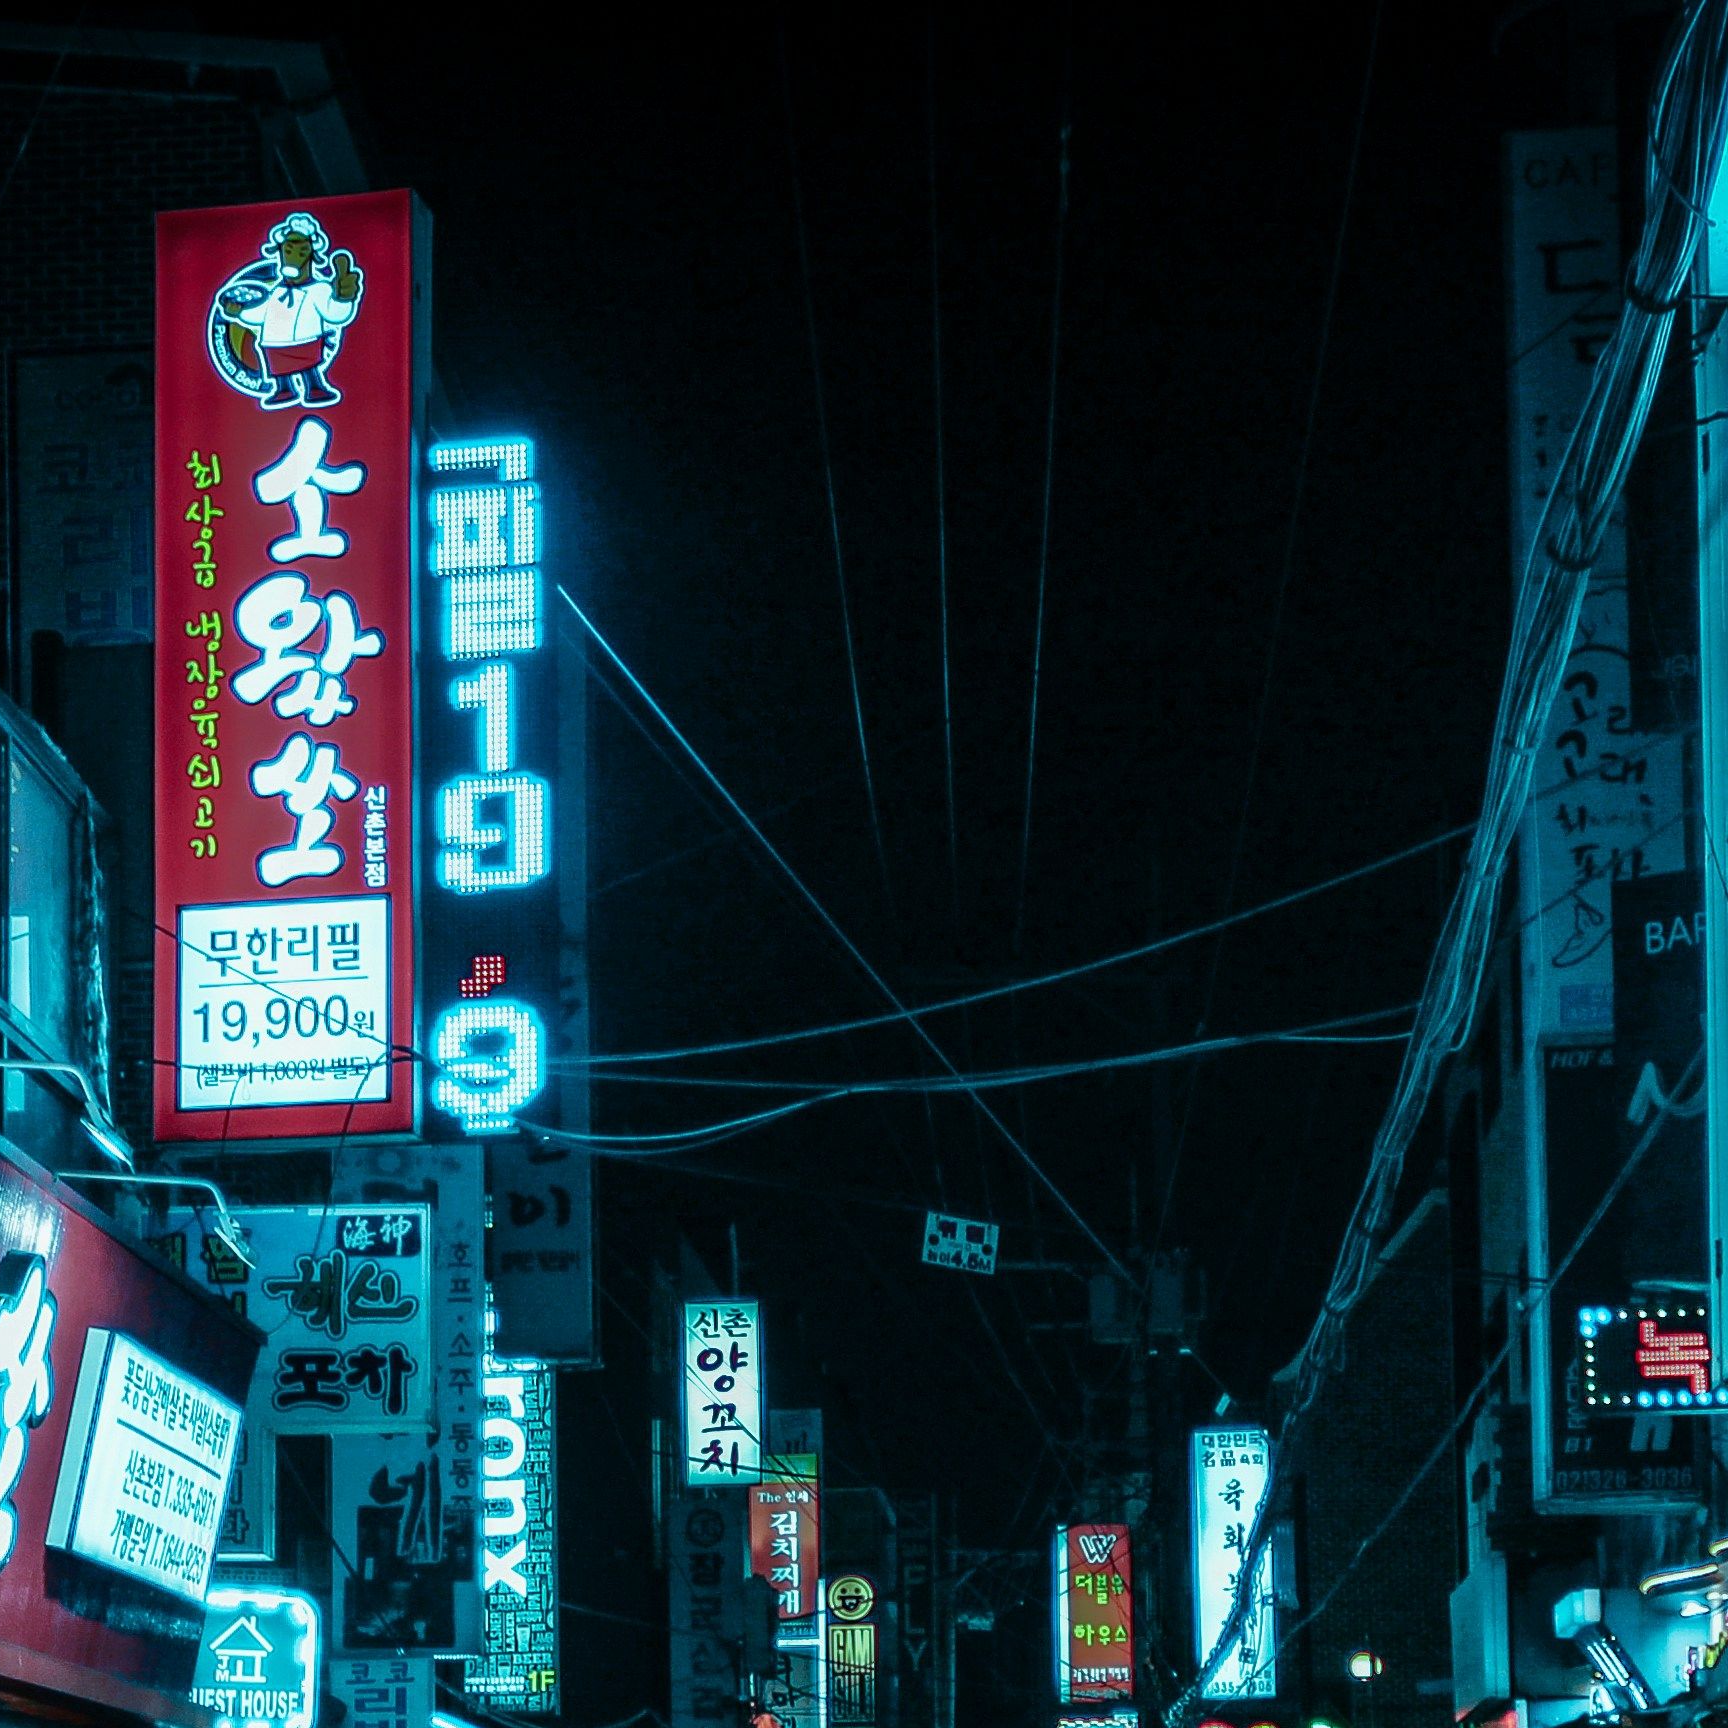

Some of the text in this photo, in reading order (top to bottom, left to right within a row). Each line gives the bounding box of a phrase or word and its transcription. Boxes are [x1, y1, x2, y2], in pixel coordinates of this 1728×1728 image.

[215, 324, 239, 377] Premium
[183, 450, 225, 588] 최상급
[362, 786, 387, 888] 신촌본점
[207, 923, 362, 978] 무한리필
[193, 994, 375, 1048] 19,900원
[343, 1216, 412, 1255] 海神
[692, 1308, 751, 1340] 신촌
[274, 1345, 416, 1414] 포차
[696, 1341, 750, 1478] 양꼬치
[1201, 1433, 1265, 1449] 대한민국
[483, 1358, 527, 1598] ronx
[758, 1492, 782, 1503] The
[770, 1510, 800, 1614] 김치찌개
[1074, 1623, 1127, 1646] 하우스
[189, 1688, 299, 1718] UEST HOUSE
[528, 1671, 555, 1692] 1F
